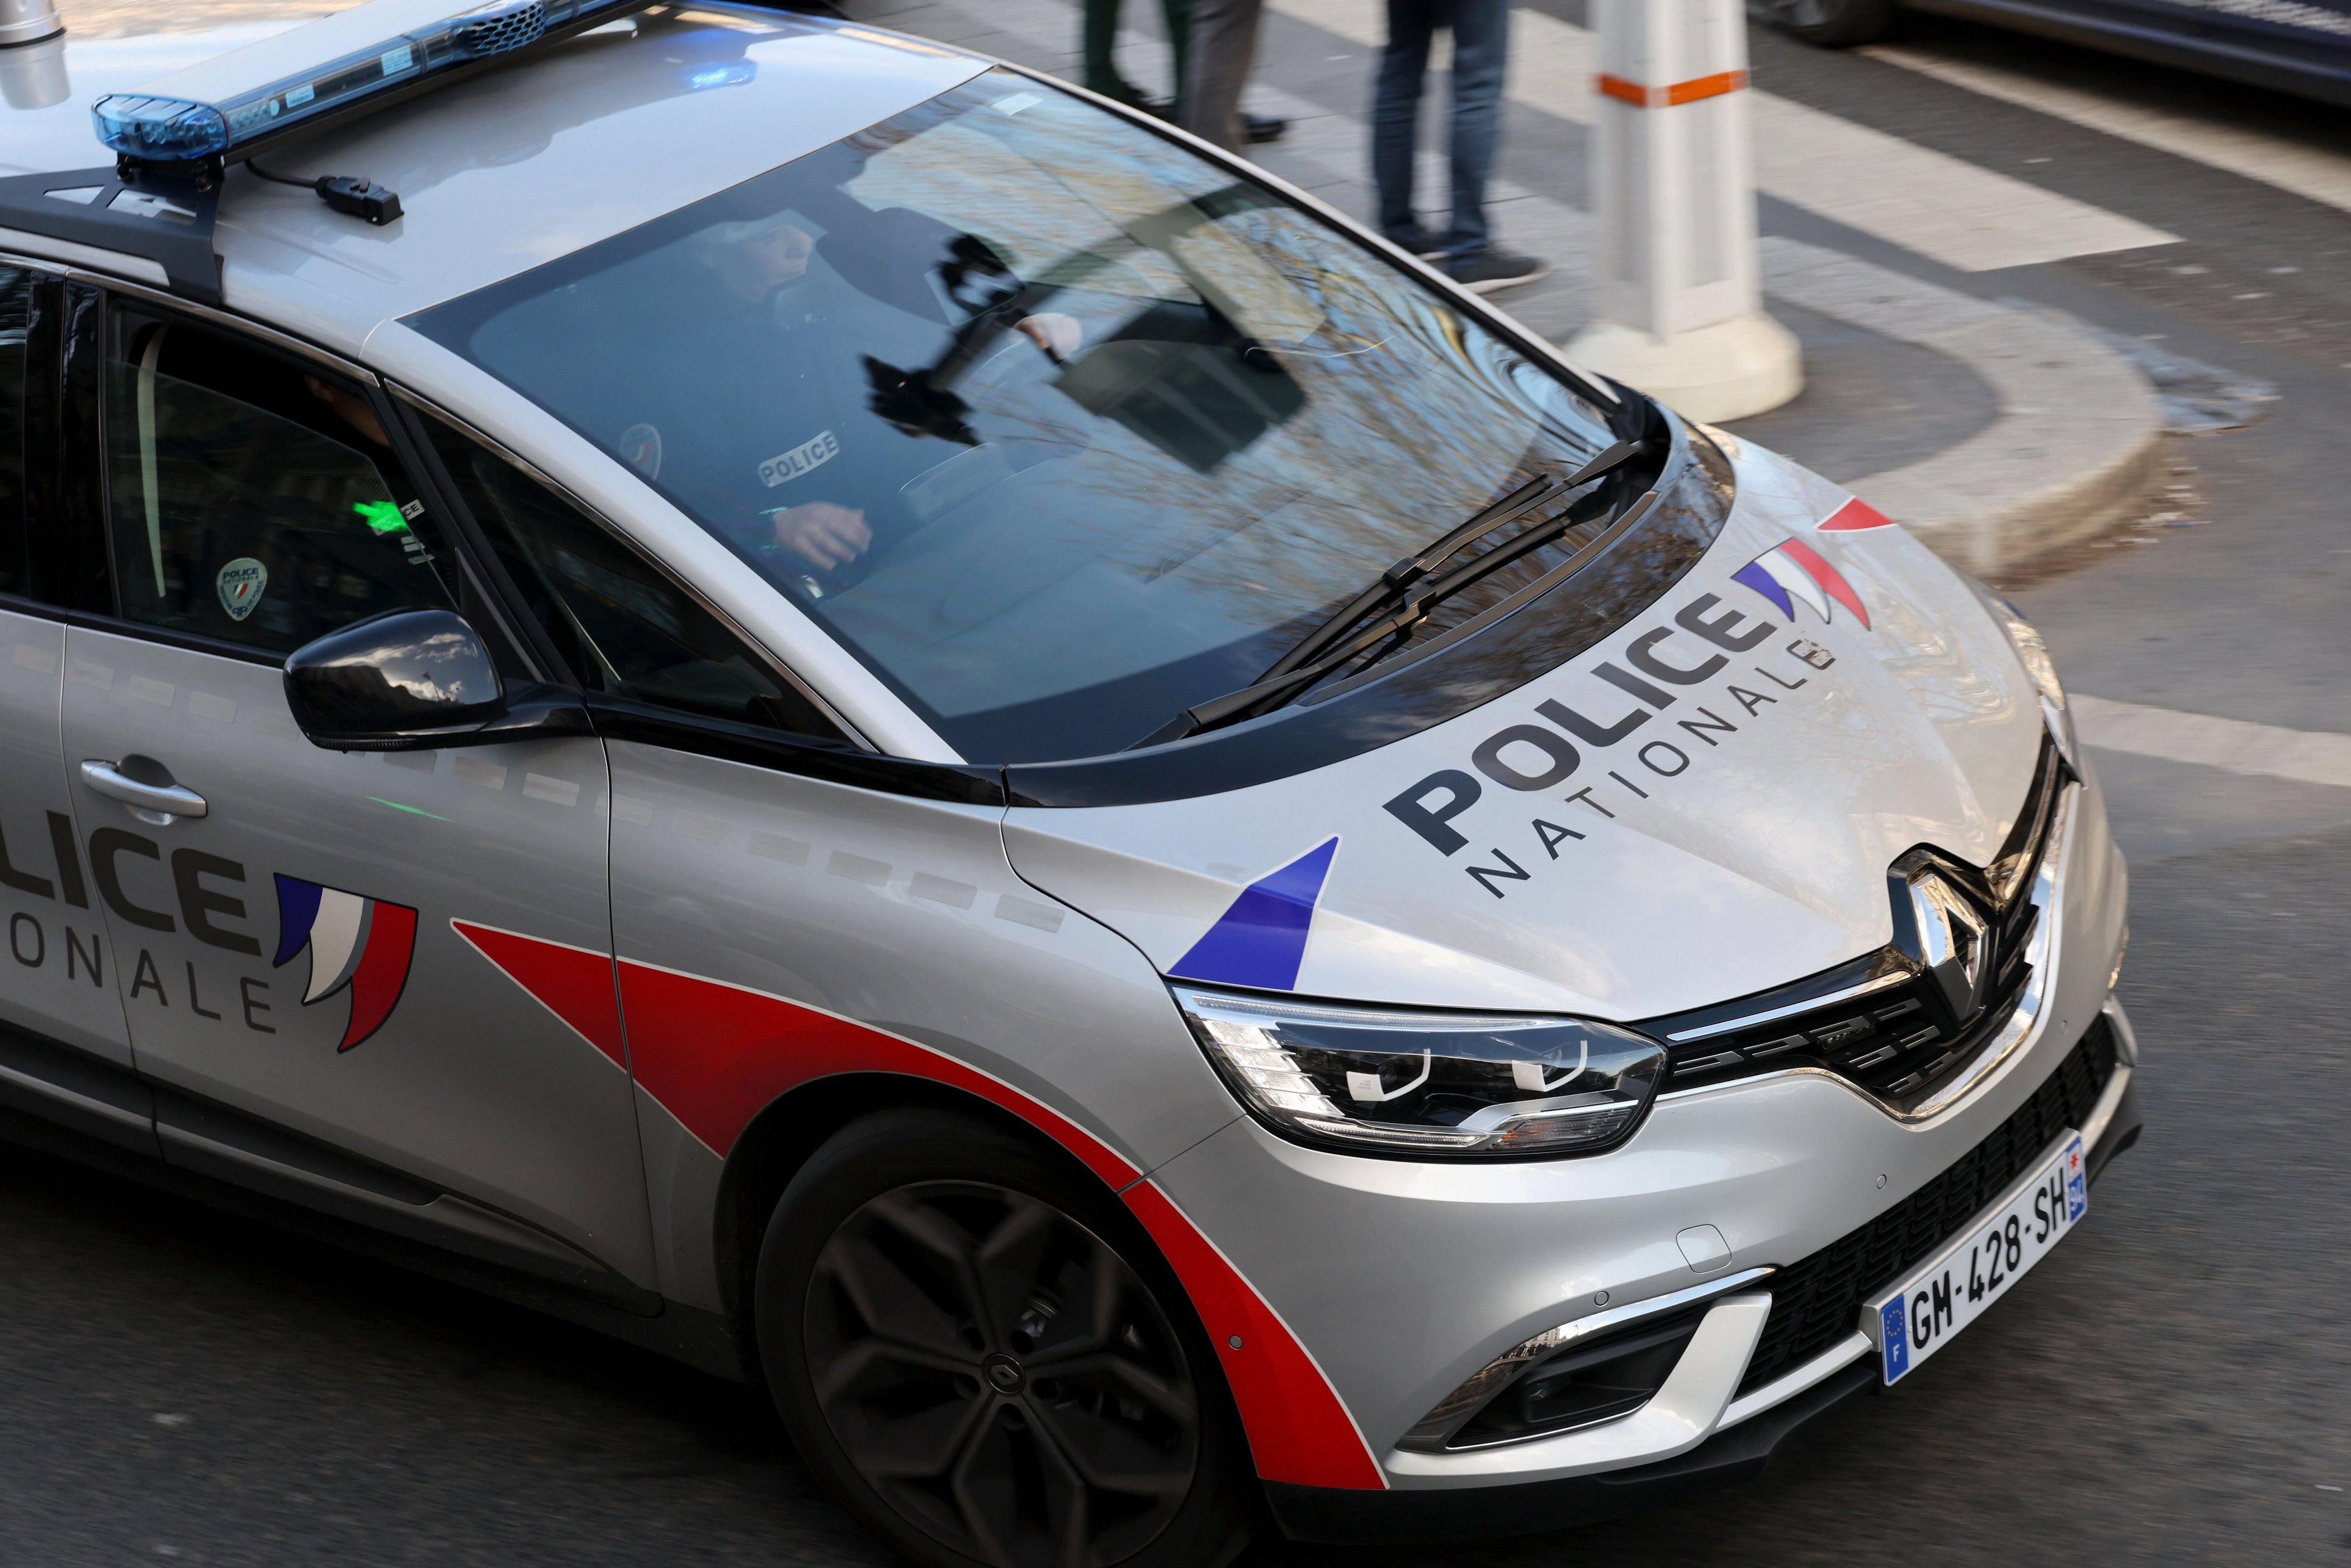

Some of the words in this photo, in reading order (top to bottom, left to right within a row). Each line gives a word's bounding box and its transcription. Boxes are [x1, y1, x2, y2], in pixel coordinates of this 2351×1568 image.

[761, 433, 837, 485] POLICE
[224, 567, 259, 579] POLICE
[224, 575, 259, 584] NATIONALE
[1382, 593, 1778, 857] POLICE
[1465, 640, 1836, 899] NATIONALE
[10, 912, 276, 1034] ONALE
[1893, 1344, 1900, 1362] F
[1912, 1167, 2067, 1349] GM-428-SH
